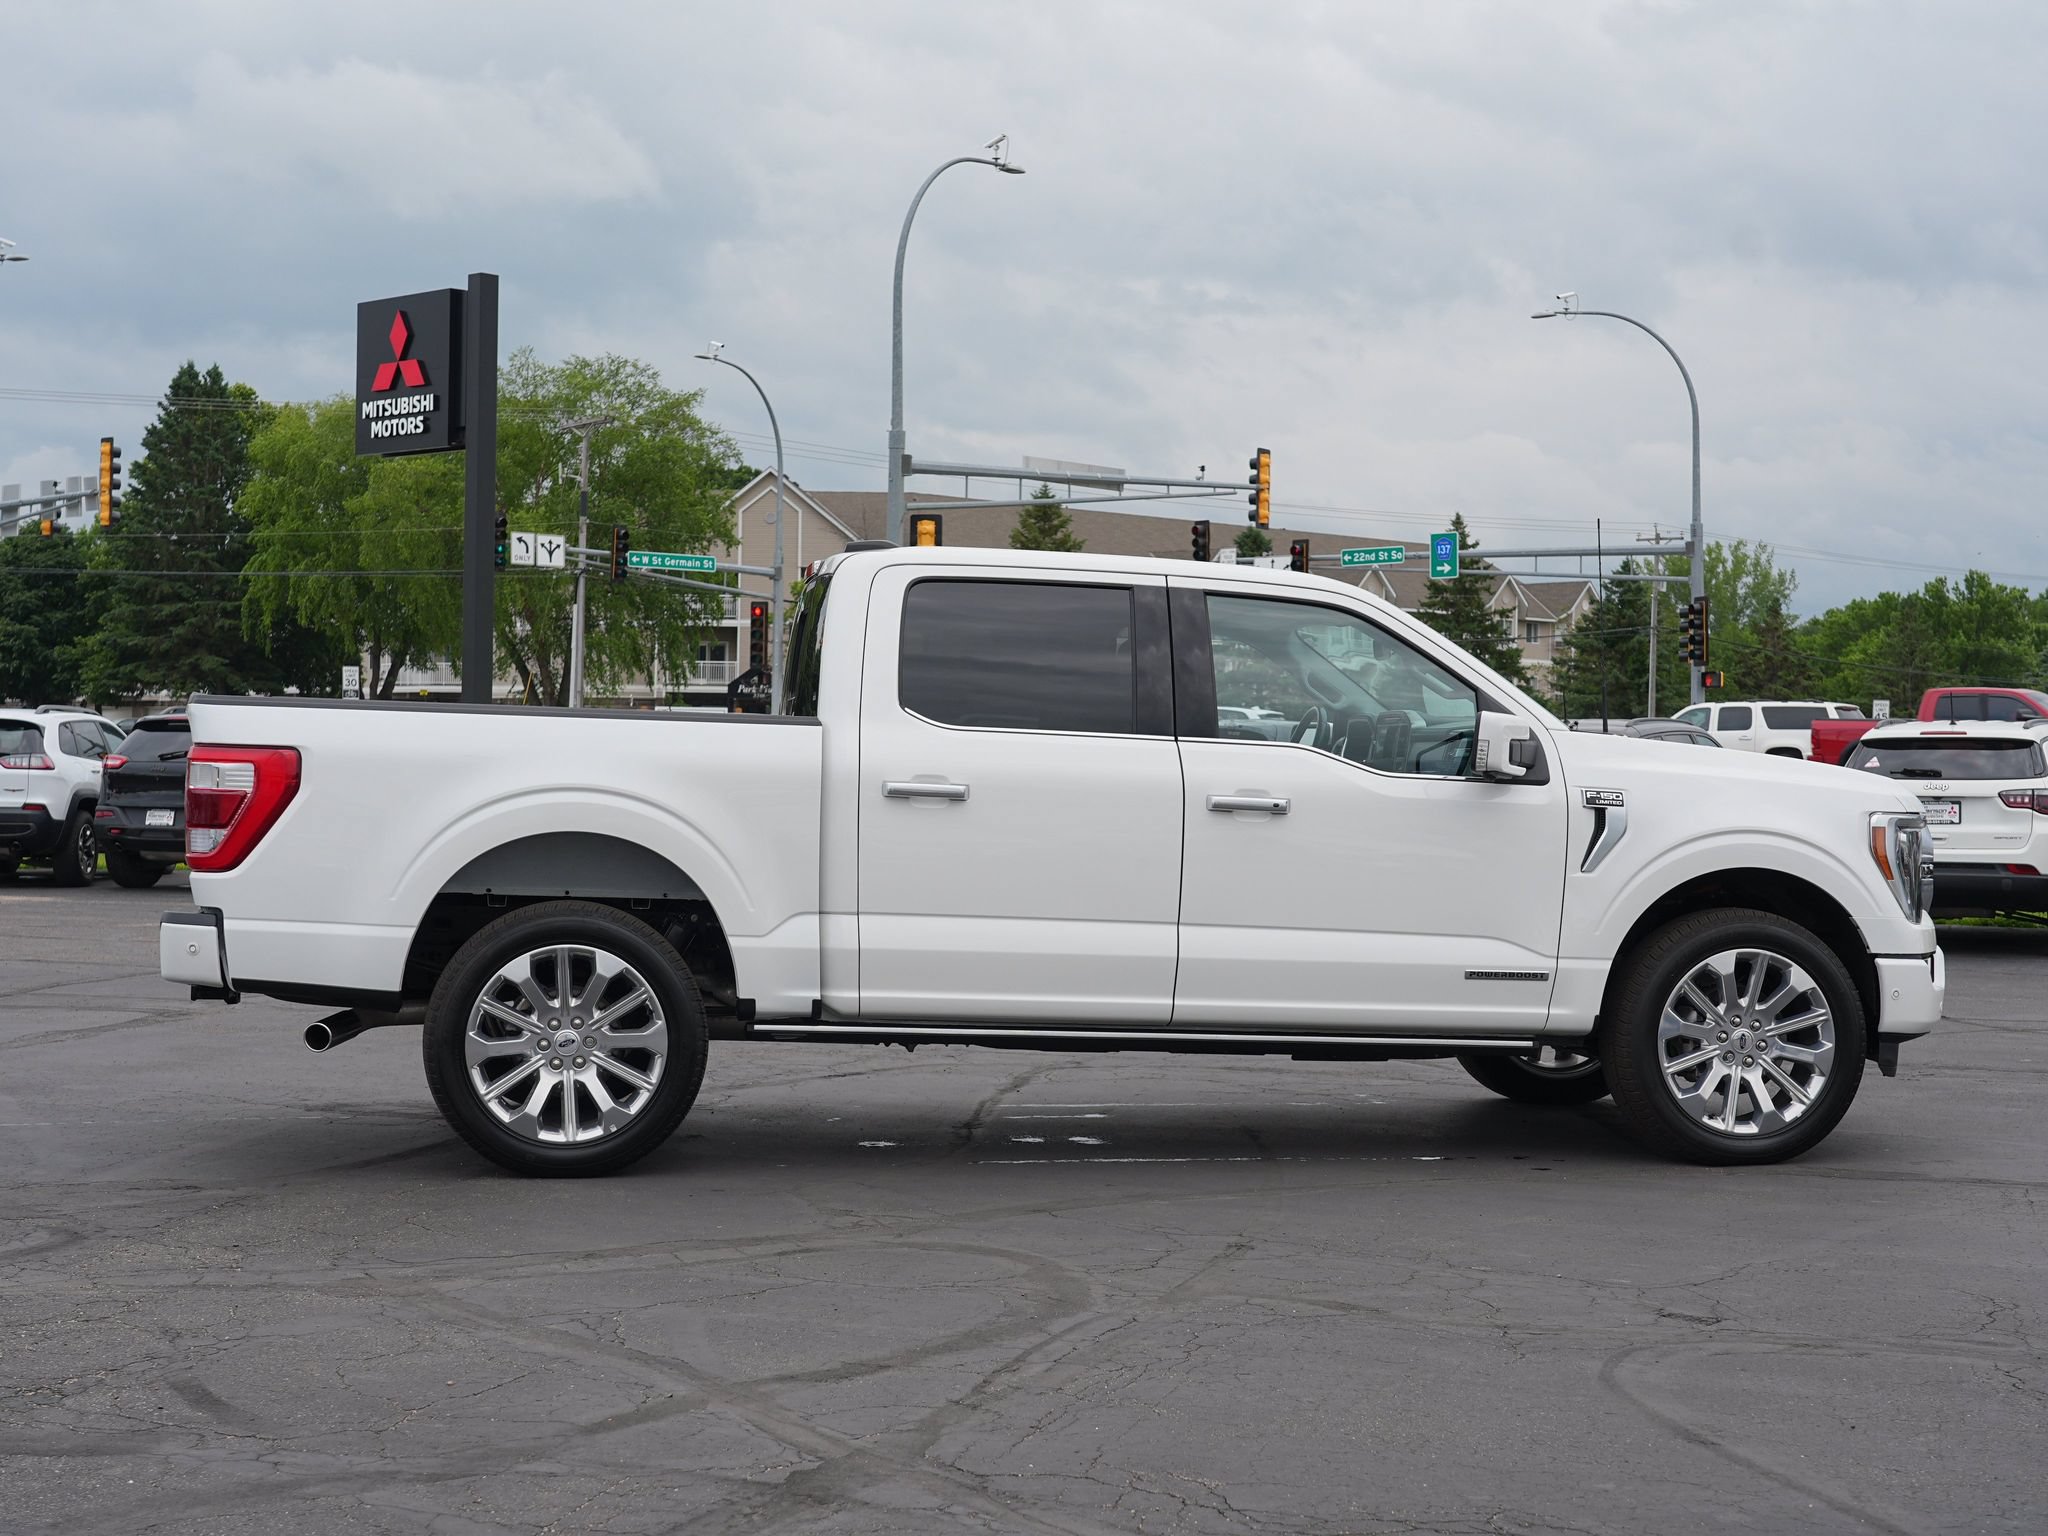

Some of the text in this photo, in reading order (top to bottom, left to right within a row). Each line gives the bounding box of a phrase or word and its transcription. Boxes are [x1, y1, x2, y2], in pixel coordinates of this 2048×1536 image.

[362, 393, 434, 420] MITSUBISHI
[370, 415, 424, 439] MOTORS
[1437, 544, 1451, 554] 137
[514, 554, 531, 562] ONLY
[1353, 550, 1403, 562] 22nd St So
[641, 555, 713, 569] W St Germain St
[344, 678, 358, 687] 30
[1874, 712, 1888, 720] 45
[1923, 781, 1950, 792] Jeep
[1586, 791, 1623, 801] F-150
[1469, 970, 1546, 980] POWERBOOST
